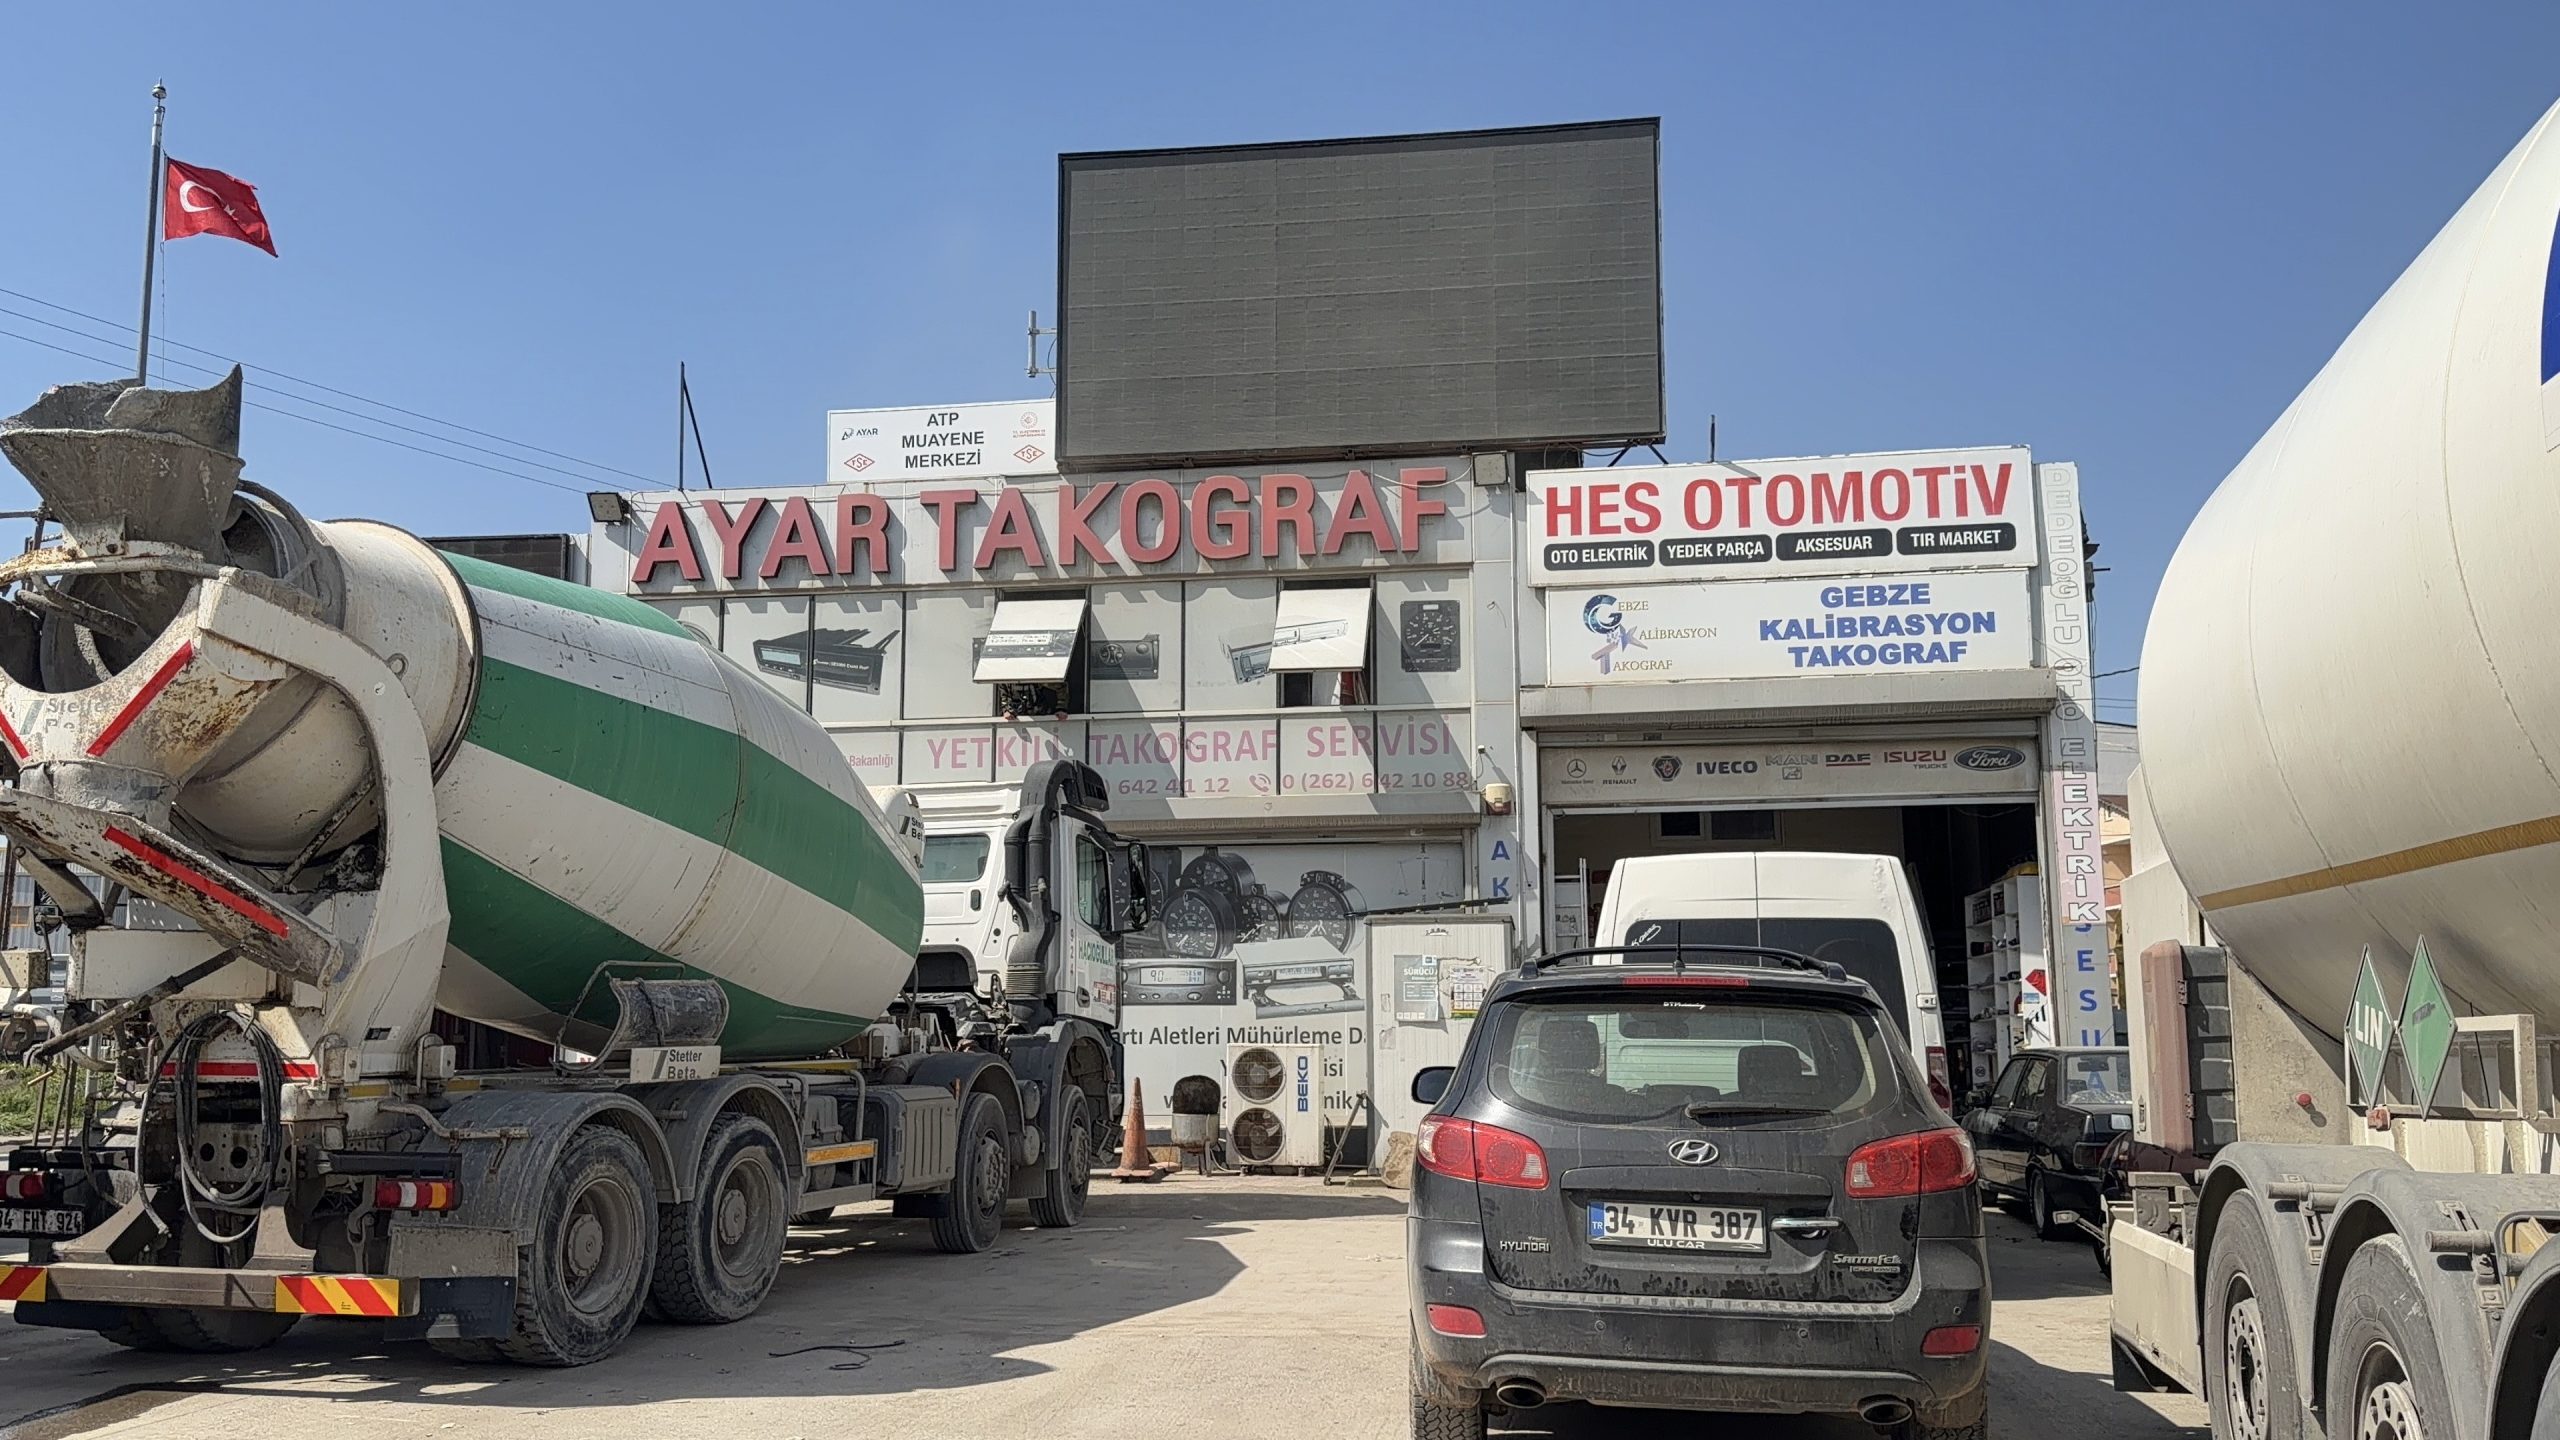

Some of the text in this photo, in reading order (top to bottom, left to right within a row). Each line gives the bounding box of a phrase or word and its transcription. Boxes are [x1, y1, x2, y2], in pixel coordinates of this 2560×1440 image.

[927, 412, 959, 427] ATP
[856, 428, 878, 436] AYAR
[902, 431, 985, 448] MUAYENE
[905, 449, 981, 469] MERKEZİ
[1546, 481, 1661, 537] HES
[631, 467, 1447, 583] AYAR TAKOGRAF
[1795, 534, 1873, 553] AKSESUAR
[1910, 529, 2002, 547] TIR MARKET
[1551, 545, 1648, 564] OTO ELEKTRİK
[1667, 542, 1765, 560] YEDEK PARÇA
[1820, 583, 1931, 608] GEBZE
[1788, 640, 1968, 668] TAKOGRAF
[2053, 664, 2085, 721] OTO
[47, 698, 107, 713] Stette
[1090, 729, 1277, 766] TAKOGRAF
[1307, 715, 1451, 758] SERVİSİ
[849, 754, 894, 768] Bakanlığı
[1765, 754, 1818, 766] MAN
[1825, 753, 1871, 763] DAF
[1884, 750, 1947, 763] ISUZU
[1967, 749, 2011, 767] Ford
[1696, 760, 1758, 775] IVECO
[1118, 779, 1158, 795] 642
[1165, 778, 1196, 793] 41
[1204, 778, 1231, 793] 12
[1282, 771, 1469, 792] 0 (262) 642 10 88
[2355, 1001, 2383, 1051] LIN
[1150, 1026, 1220, 1045] Aletleri
[1227, 1026, 1342, 1045] Mühürleme
[669, 1049, 702, 1062] Stetter
[1297, 1056, 1309, 1112] BEKO
[23, 1210, 47, 1231] FHT
[1592, 1221, 1604, 1230] TR
[1605, 1206, 1758, 1240] 34 KVR 387
[1500, 1241, 1550, 1251] HYUNDAI
[1647, 1239, 1705, 1249] ULU CAR
